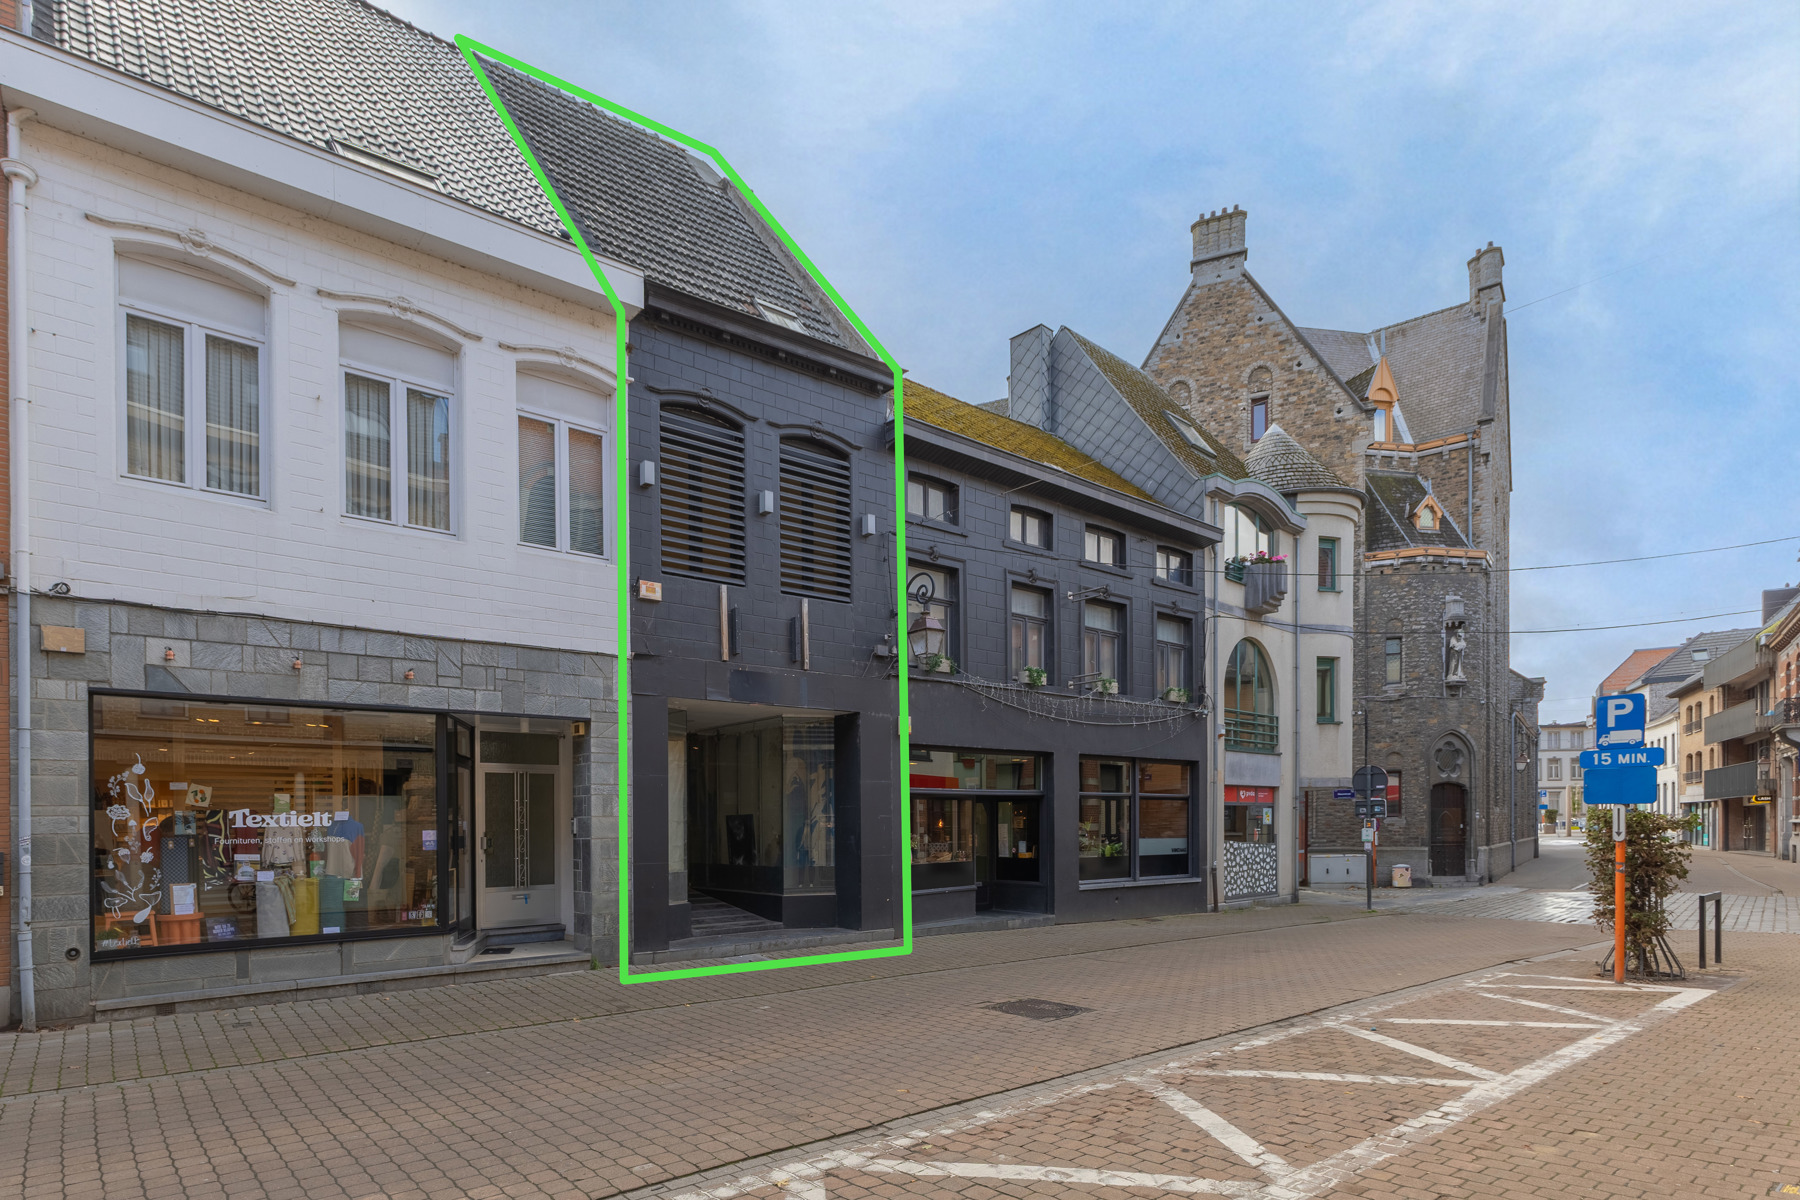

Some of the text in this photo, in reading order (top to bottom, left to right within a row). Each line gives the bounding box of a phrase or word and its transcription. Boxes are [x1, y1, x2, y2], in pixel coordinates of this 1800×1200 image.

[1606, 698, 1634, 728] P
[1593, 752, 1651, 765] 15 MIN.
[228, 808, 333, 828] Textielt
[214, 837, 263, 846] Fournituren,
[264, 836, 292, 844] stoffen
[305, 835, 345, 845] workshops
